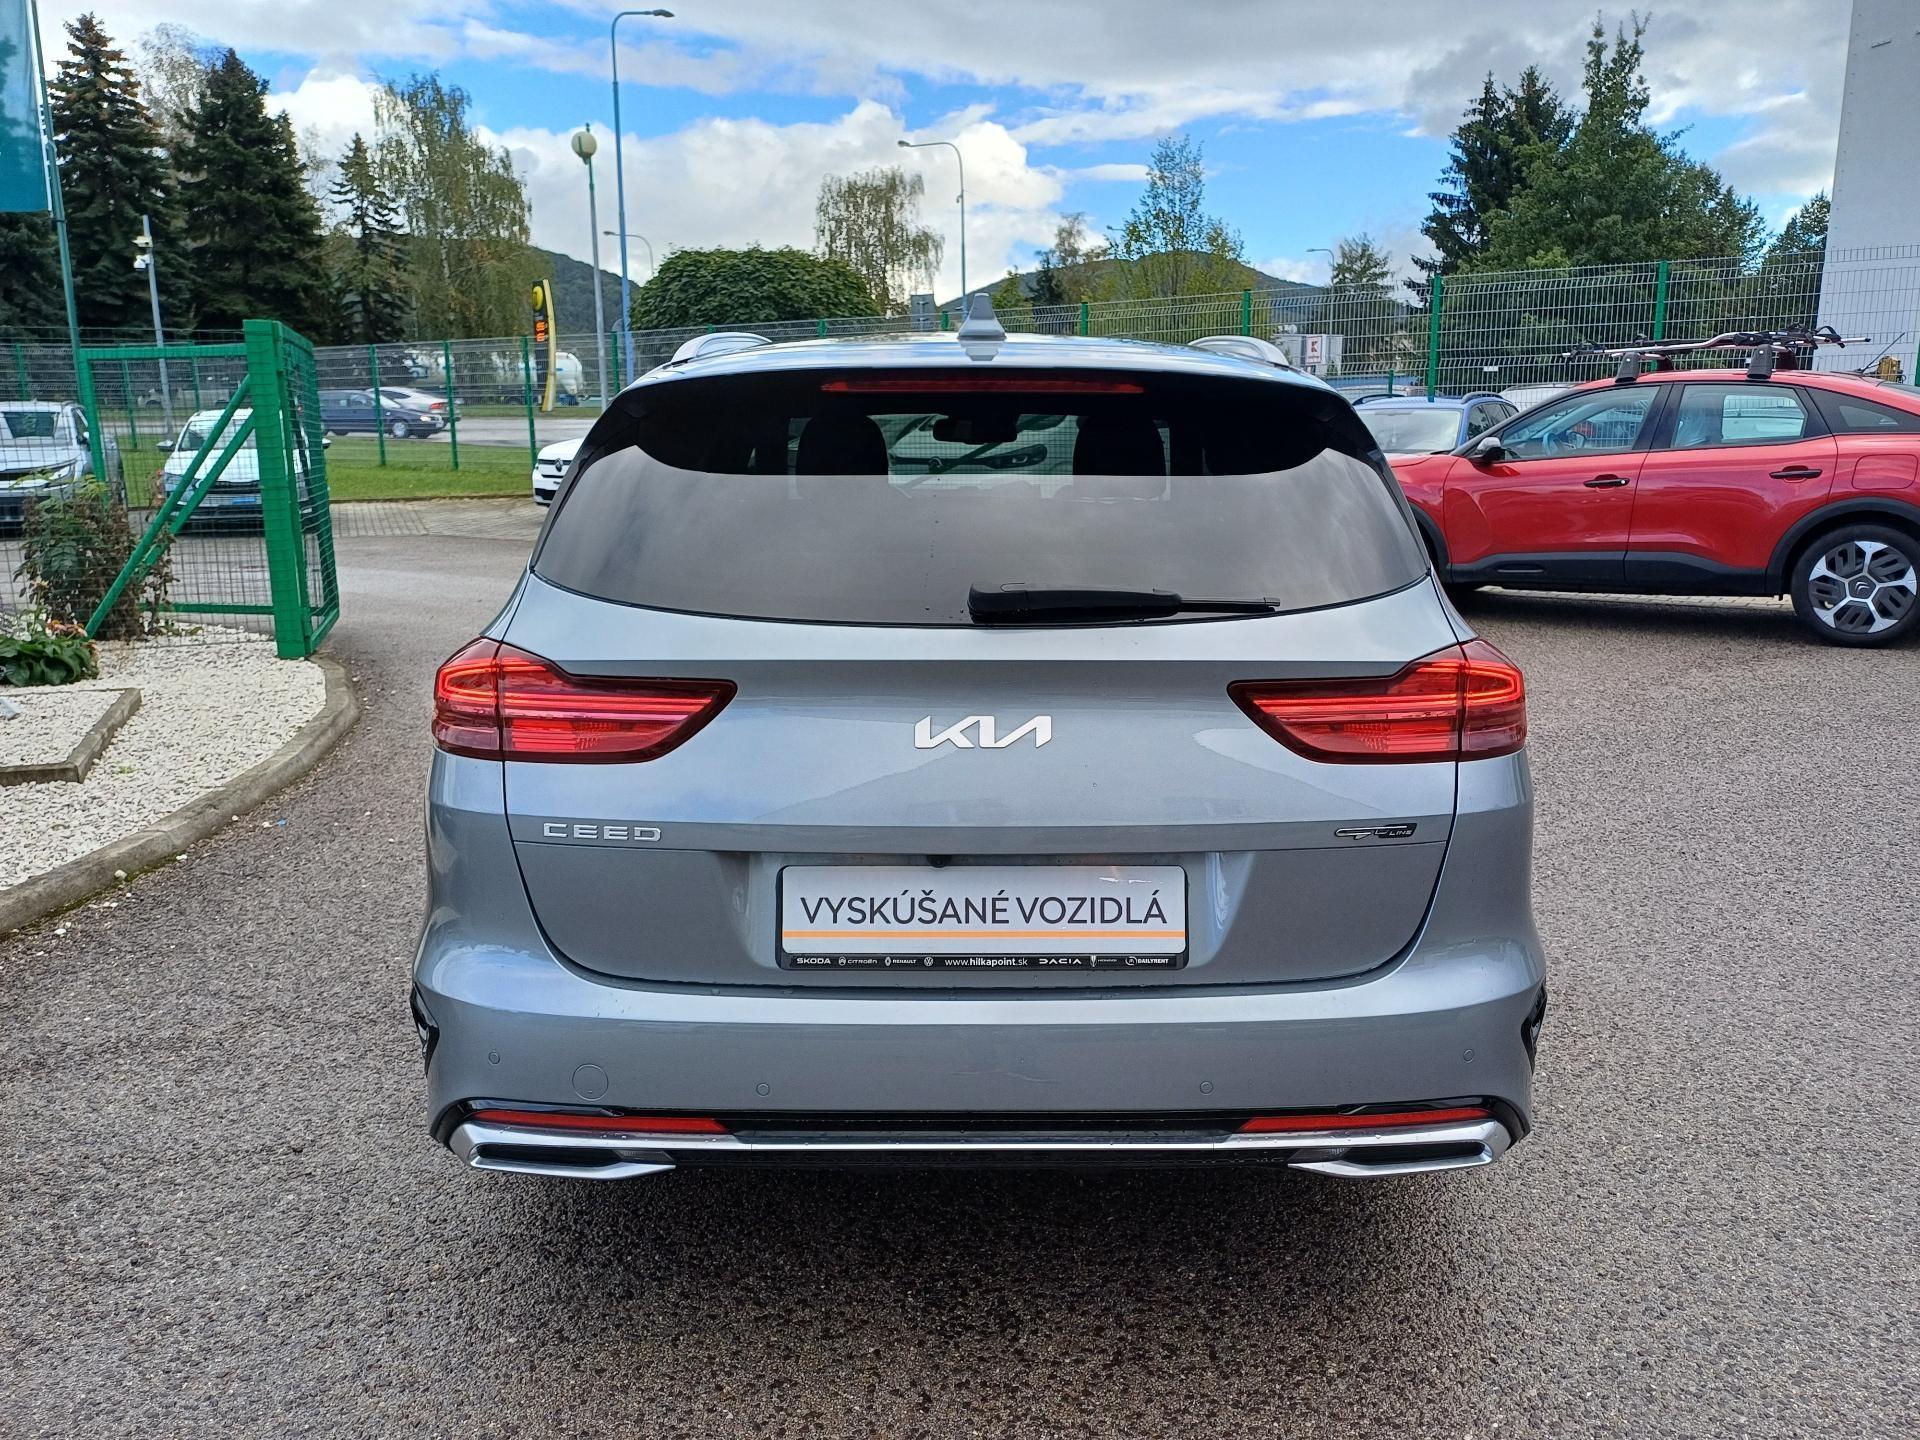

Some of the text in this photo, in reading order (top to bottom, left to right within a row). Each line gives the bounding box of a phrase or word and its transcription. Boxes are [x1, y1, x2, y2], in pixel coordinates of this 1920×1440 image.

[543, 822, 661, 842] CEED
[799, 889, 1168, 925] VYSKÚŠANÉ VOZIDLÁ
[944, 957, 1028, 968] www.hilkapoint.sk
